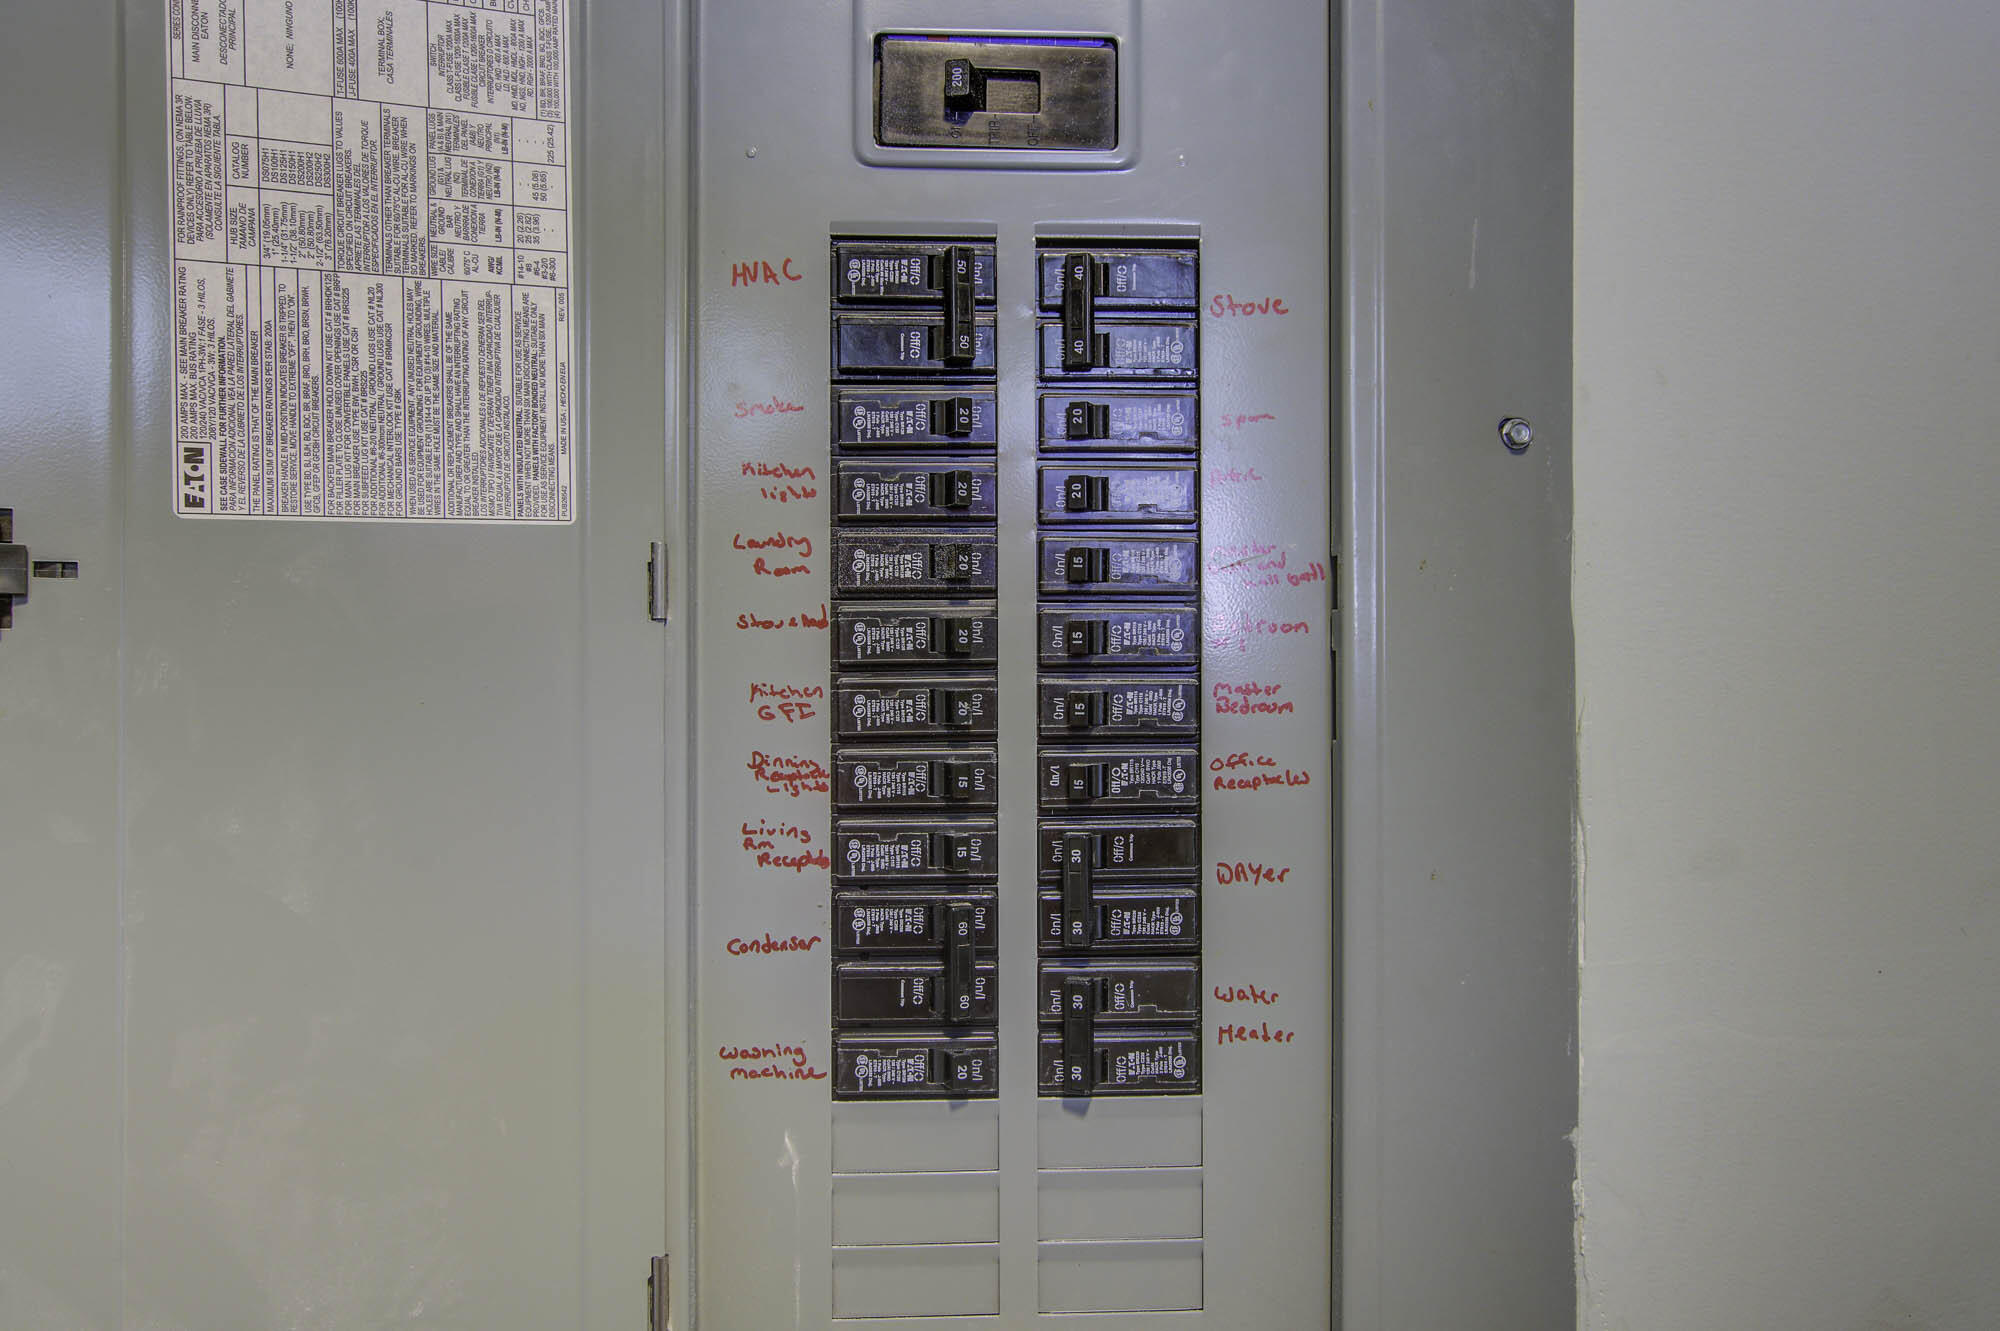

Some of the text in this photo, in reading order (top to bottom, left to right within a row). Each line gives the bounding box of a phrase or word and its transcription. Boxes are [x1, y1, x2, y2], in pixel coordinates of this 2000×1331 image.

[285, 1, 293, 39] NINGUNO
[228, 9, 236, 50] PRINCIPAL
[952, 68, 962, 86] 200
[232, 142, 240, 179] CATALOG
[731, 258, 802, 287] HVAC
[958, 260, 966, 273] 50
[1075, 266, 1083, 280] 40
[1209, 294, 1289, 319] Stove
[960, 336, 969, 348] 50
[1075, 341, 1083, 354] 40
[189, 364, 197, 379] BUS
[265, 378, 273, 409] RATINGS
[960, 408, 969, 423] 20
[1073, 409, 1082, 423] 20
[190, 426, 198, 439] 200
[266, 448, 273, 457] OF
[184, 447, 204, 508] EATON
[958, 482, 967, 496] 20
[1072, 484, 1081, 498] 20
[733, 531, 812, 557] Laundry
[753, 557, 810, 577] Room
[959, 555, 968, 570] 20
[1073, 557, 1082, 567] 15
[959, 630, 968, 643] 20
[1073, 632, 1082, 643] 15
[750, 682, 823, 702] Kitchen
[757, 702, 816, 723] GFI
[959, 702, 968, 715] 20
[1075, 703, 1084, 714] 15
[959, 777, 967, 787] 15
[1074, 780, 1083, 789] 15
[742, 819, 811, 843] Living
[743, 838, 775, 850] Rm
[958, 847, 966, 857] 15
[1072, 850, 1080, 863] 30
[959, 922, 967, 935] 60
[1073, 922, 1082, 934] 30
[727, 933, 822, 956] Condenser
[960, 996, 969, 1008] 60
[1073, 995, 1082, 1009] 30
[1218, 1022, 1295, 1045] Heater
[730, 1064, 827, 1080] machine
[958, 1066, 967, 1079] 20
[1072, 1066, 1081, 1080] 30
